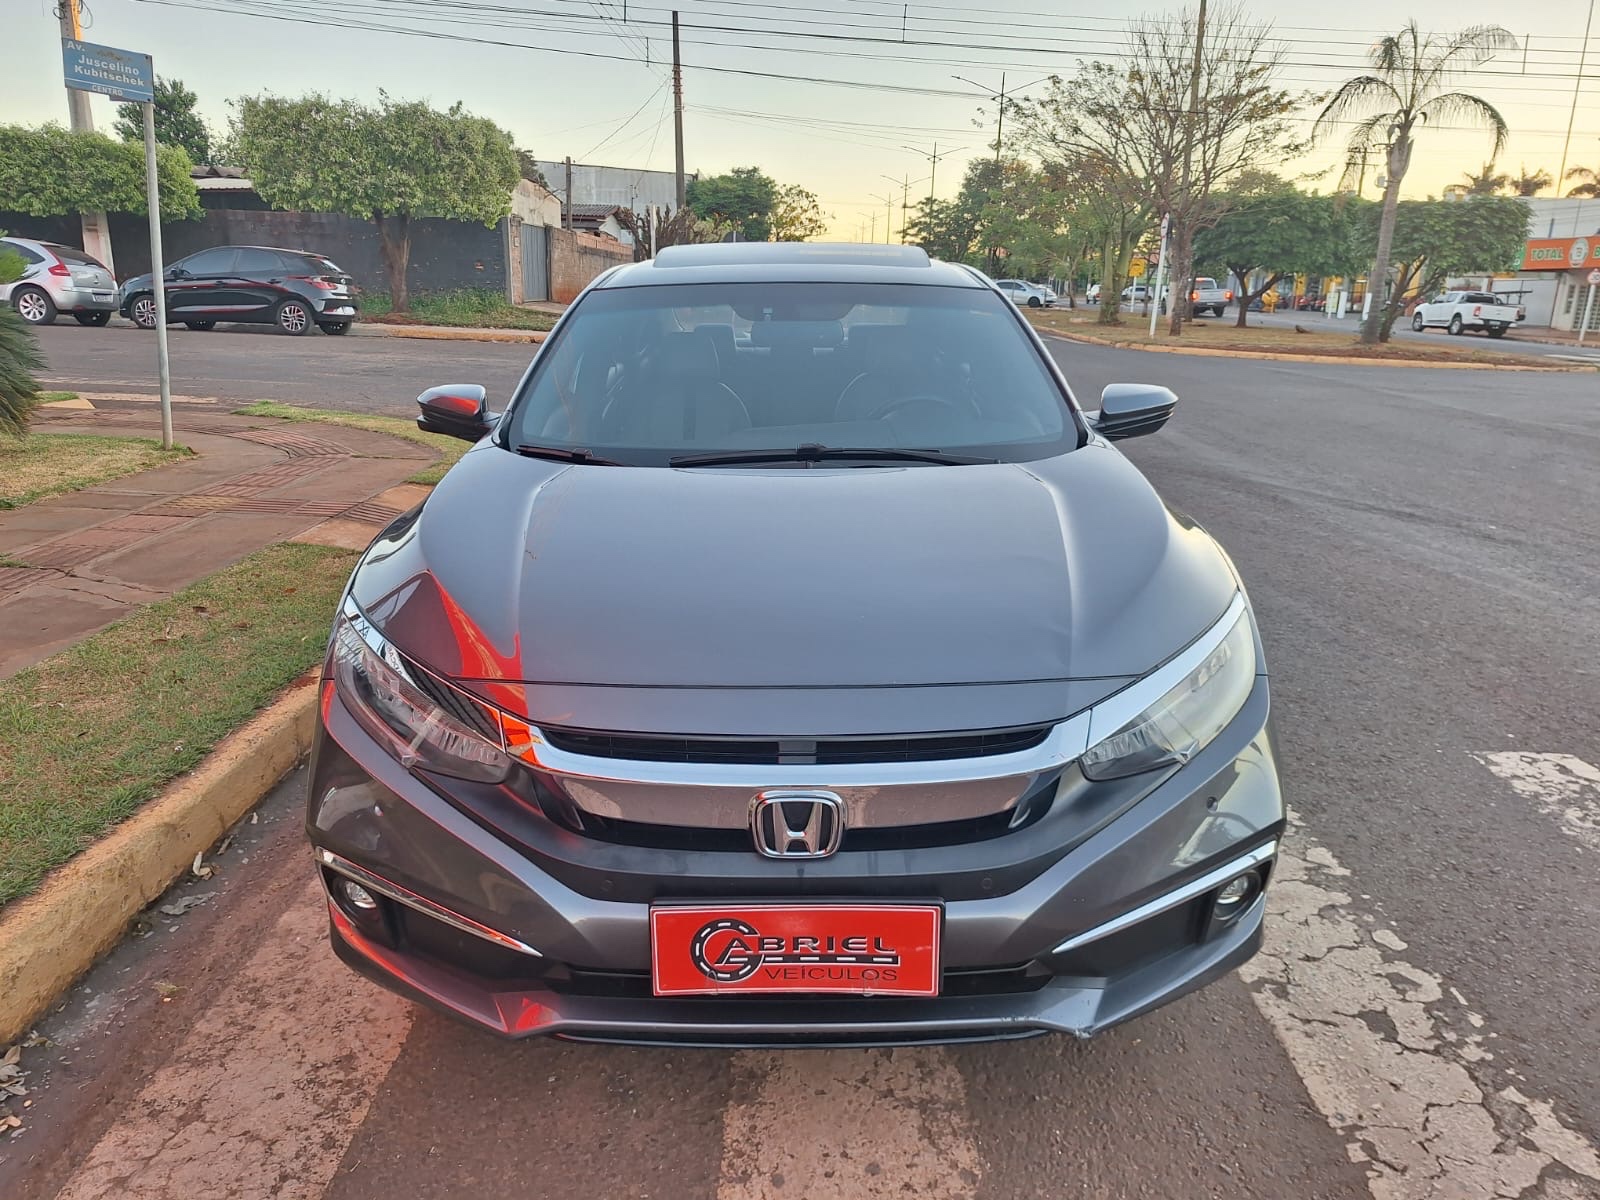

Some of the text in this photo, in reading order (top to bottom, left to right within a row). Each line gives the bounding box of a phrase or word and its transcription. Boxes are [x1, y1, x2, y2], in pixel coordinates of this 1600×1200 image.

[67, 40, 86, 52] Av.
[78, 54, 139, 76] Juscelino
[74, 64, 145, 87] Kubitschek
[91, 84, 123, 97] CENTRO
[1531, 247, 1564, 262] TOTAL
[764, 965, 898, 981] VEÍCULOS
